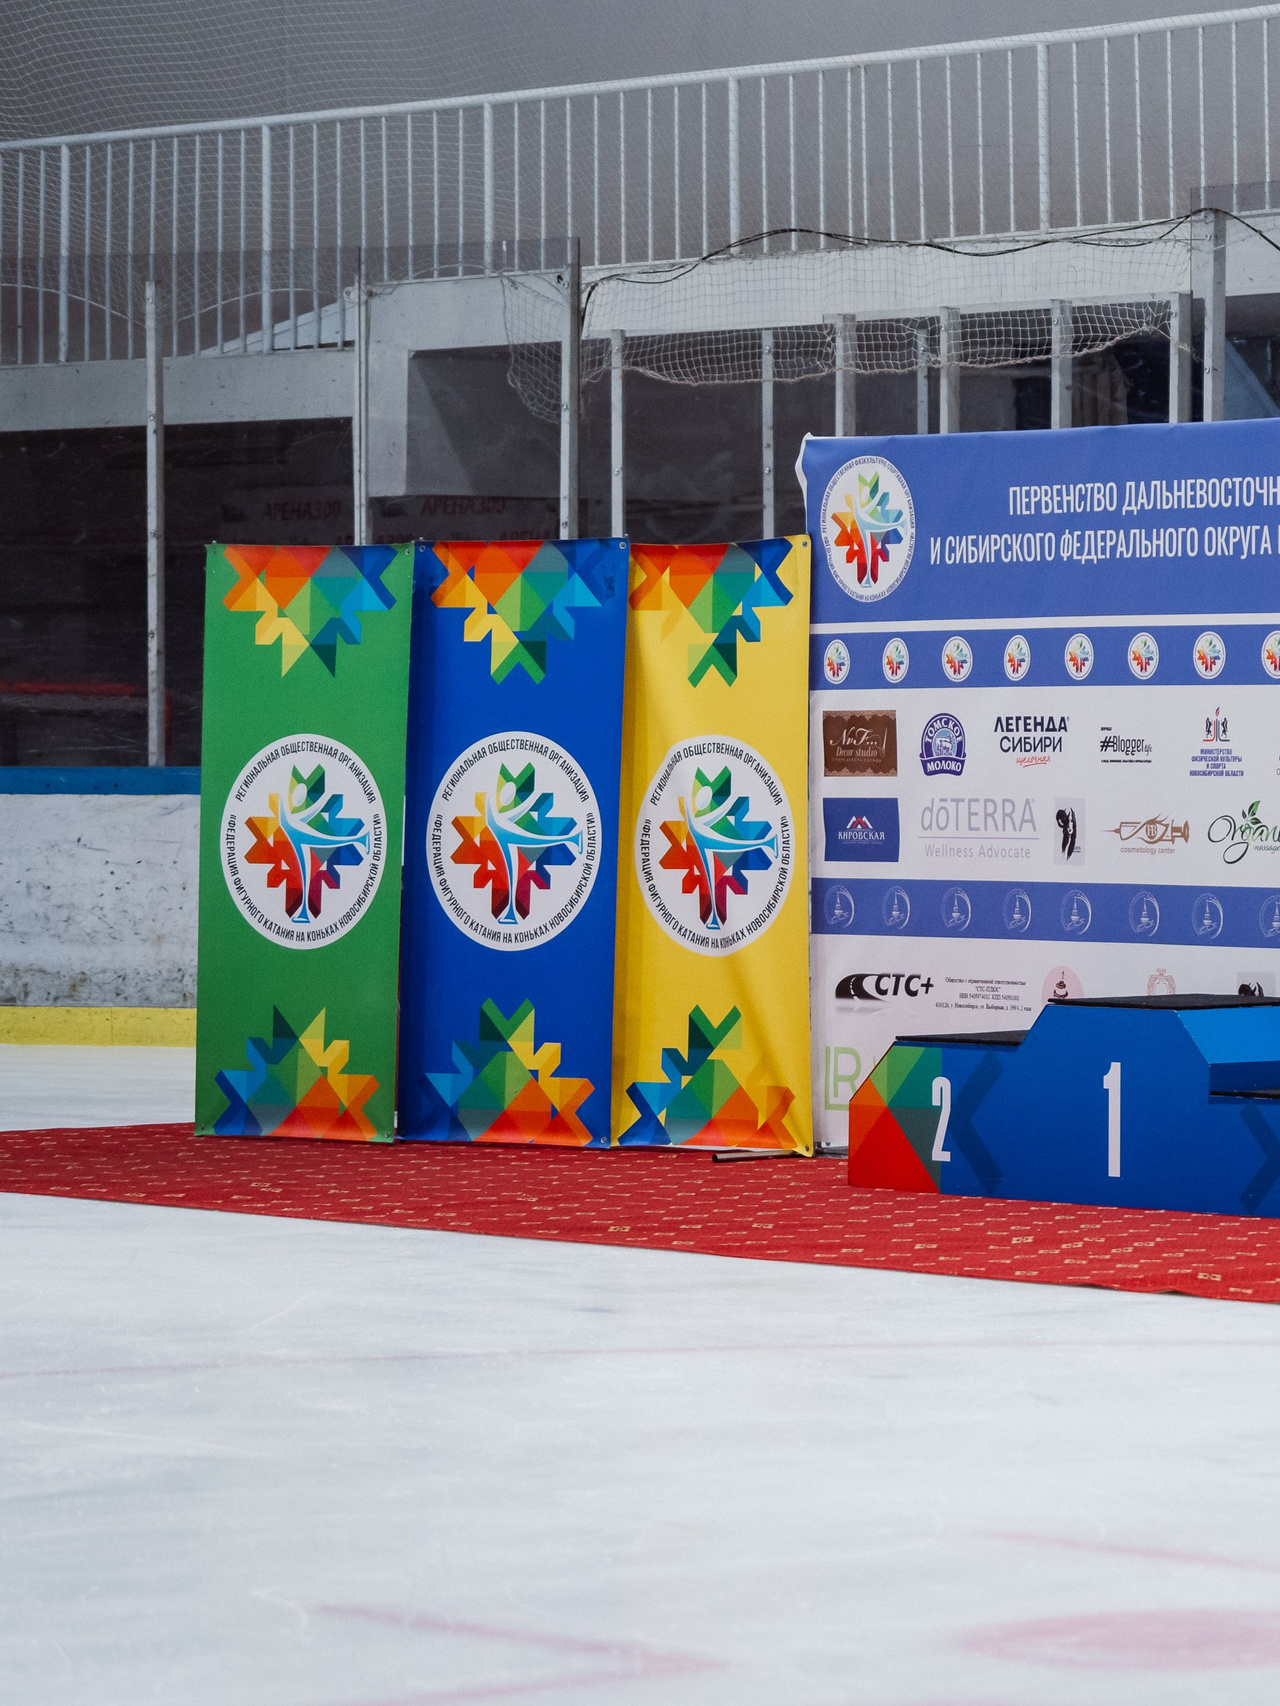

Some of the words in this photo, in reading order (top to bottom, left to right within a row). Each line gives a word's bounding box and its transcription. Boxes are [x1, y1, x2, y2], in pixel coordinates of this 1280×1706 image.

[1009, 481, 1118, 516] ПЕРВЕНСТВО
[930, 536, 941, 565] И
[945, 531, 1056, 565] СИБИРСКОГО
[1060, 526, 1199, 565] ФЕДЕРАЛЬНОГО
[1204, 522, 1272, 560] ОКРУГА
[924, 717, 964, 744] ТОМСКОЕ
[994, 715, 1068, 733] ЛЕГЕНДА
[835, 746, 854, 758] Decor
[855, 746, 878, 758] studio
[999, 735, 1063, 753] СИБИРИ
[1100, 735, 1144, 756] #Blogger
[235, 748, 280, 802] РЕГИОНАЛЬНАЯ
[280, 741, 338, 757] ОБЩЕСТВЕННАЯ
[338, 752, 377, 804] ОРГАНИЗАЦИЯ
[441, 746, 488, 802] РЕГИОНАЛЬНАЯ
[487, 738, 549, 757] ОБЩЕСТВЕННАЯ
[549, 750, 590, 803] ОРГАНИЗАЦИЯ
[650, 751, 684, 806] РЕГИОНАЛЬНАЯ
[682, 742, 744, 759] ОБЩЕСТВЕННАЯ
[743, 753, 783, 806] ОРГАНИЗАЦИЯ
[926, 760, 962, 773] МОЛОКО
[838, 831, 885, 841] КИРОВСКАЯ
[925, 843, 974, 858] Wellness
[979, 844, 1031, 859] Advocate
[1120, 846, 1157, 856] cosmetology
[1158, 847, 1175, 855] center
[233, 877, 264, 924] ФИГУРНОГО
[263, 919, 294, 941] КАТАНИЯ
[295, 931, 306, 942] НА
[306, 923, 340, 942] КОНЬКАХ
[339, 862, 379, 927] НОВОСИБИРСКОЙ
[438, 877, 470, 925] ФИГУРНОГО
[468, 920, 502, 943] КАТАНИЯ
[502, 932, 513, 944] НА
[514, 923, 550, 944] КОНЬКАХ
[549, 862, 593, 930] НОВОСИБИРСКОЙ
[647, 883, 678, 930] ФИГУРНОГО
[677, 927, 710, 948] КАТАНИЯ
[711, 938, 720, 949] НА
[720, 928, 747, 949] КОНЬКАХ
[746, 867, 789, 935] НОВОСИБИРСКОЙ
[932, 1076, 951, 1162] 2
[1103, 1062, 1121, 1177] 1
